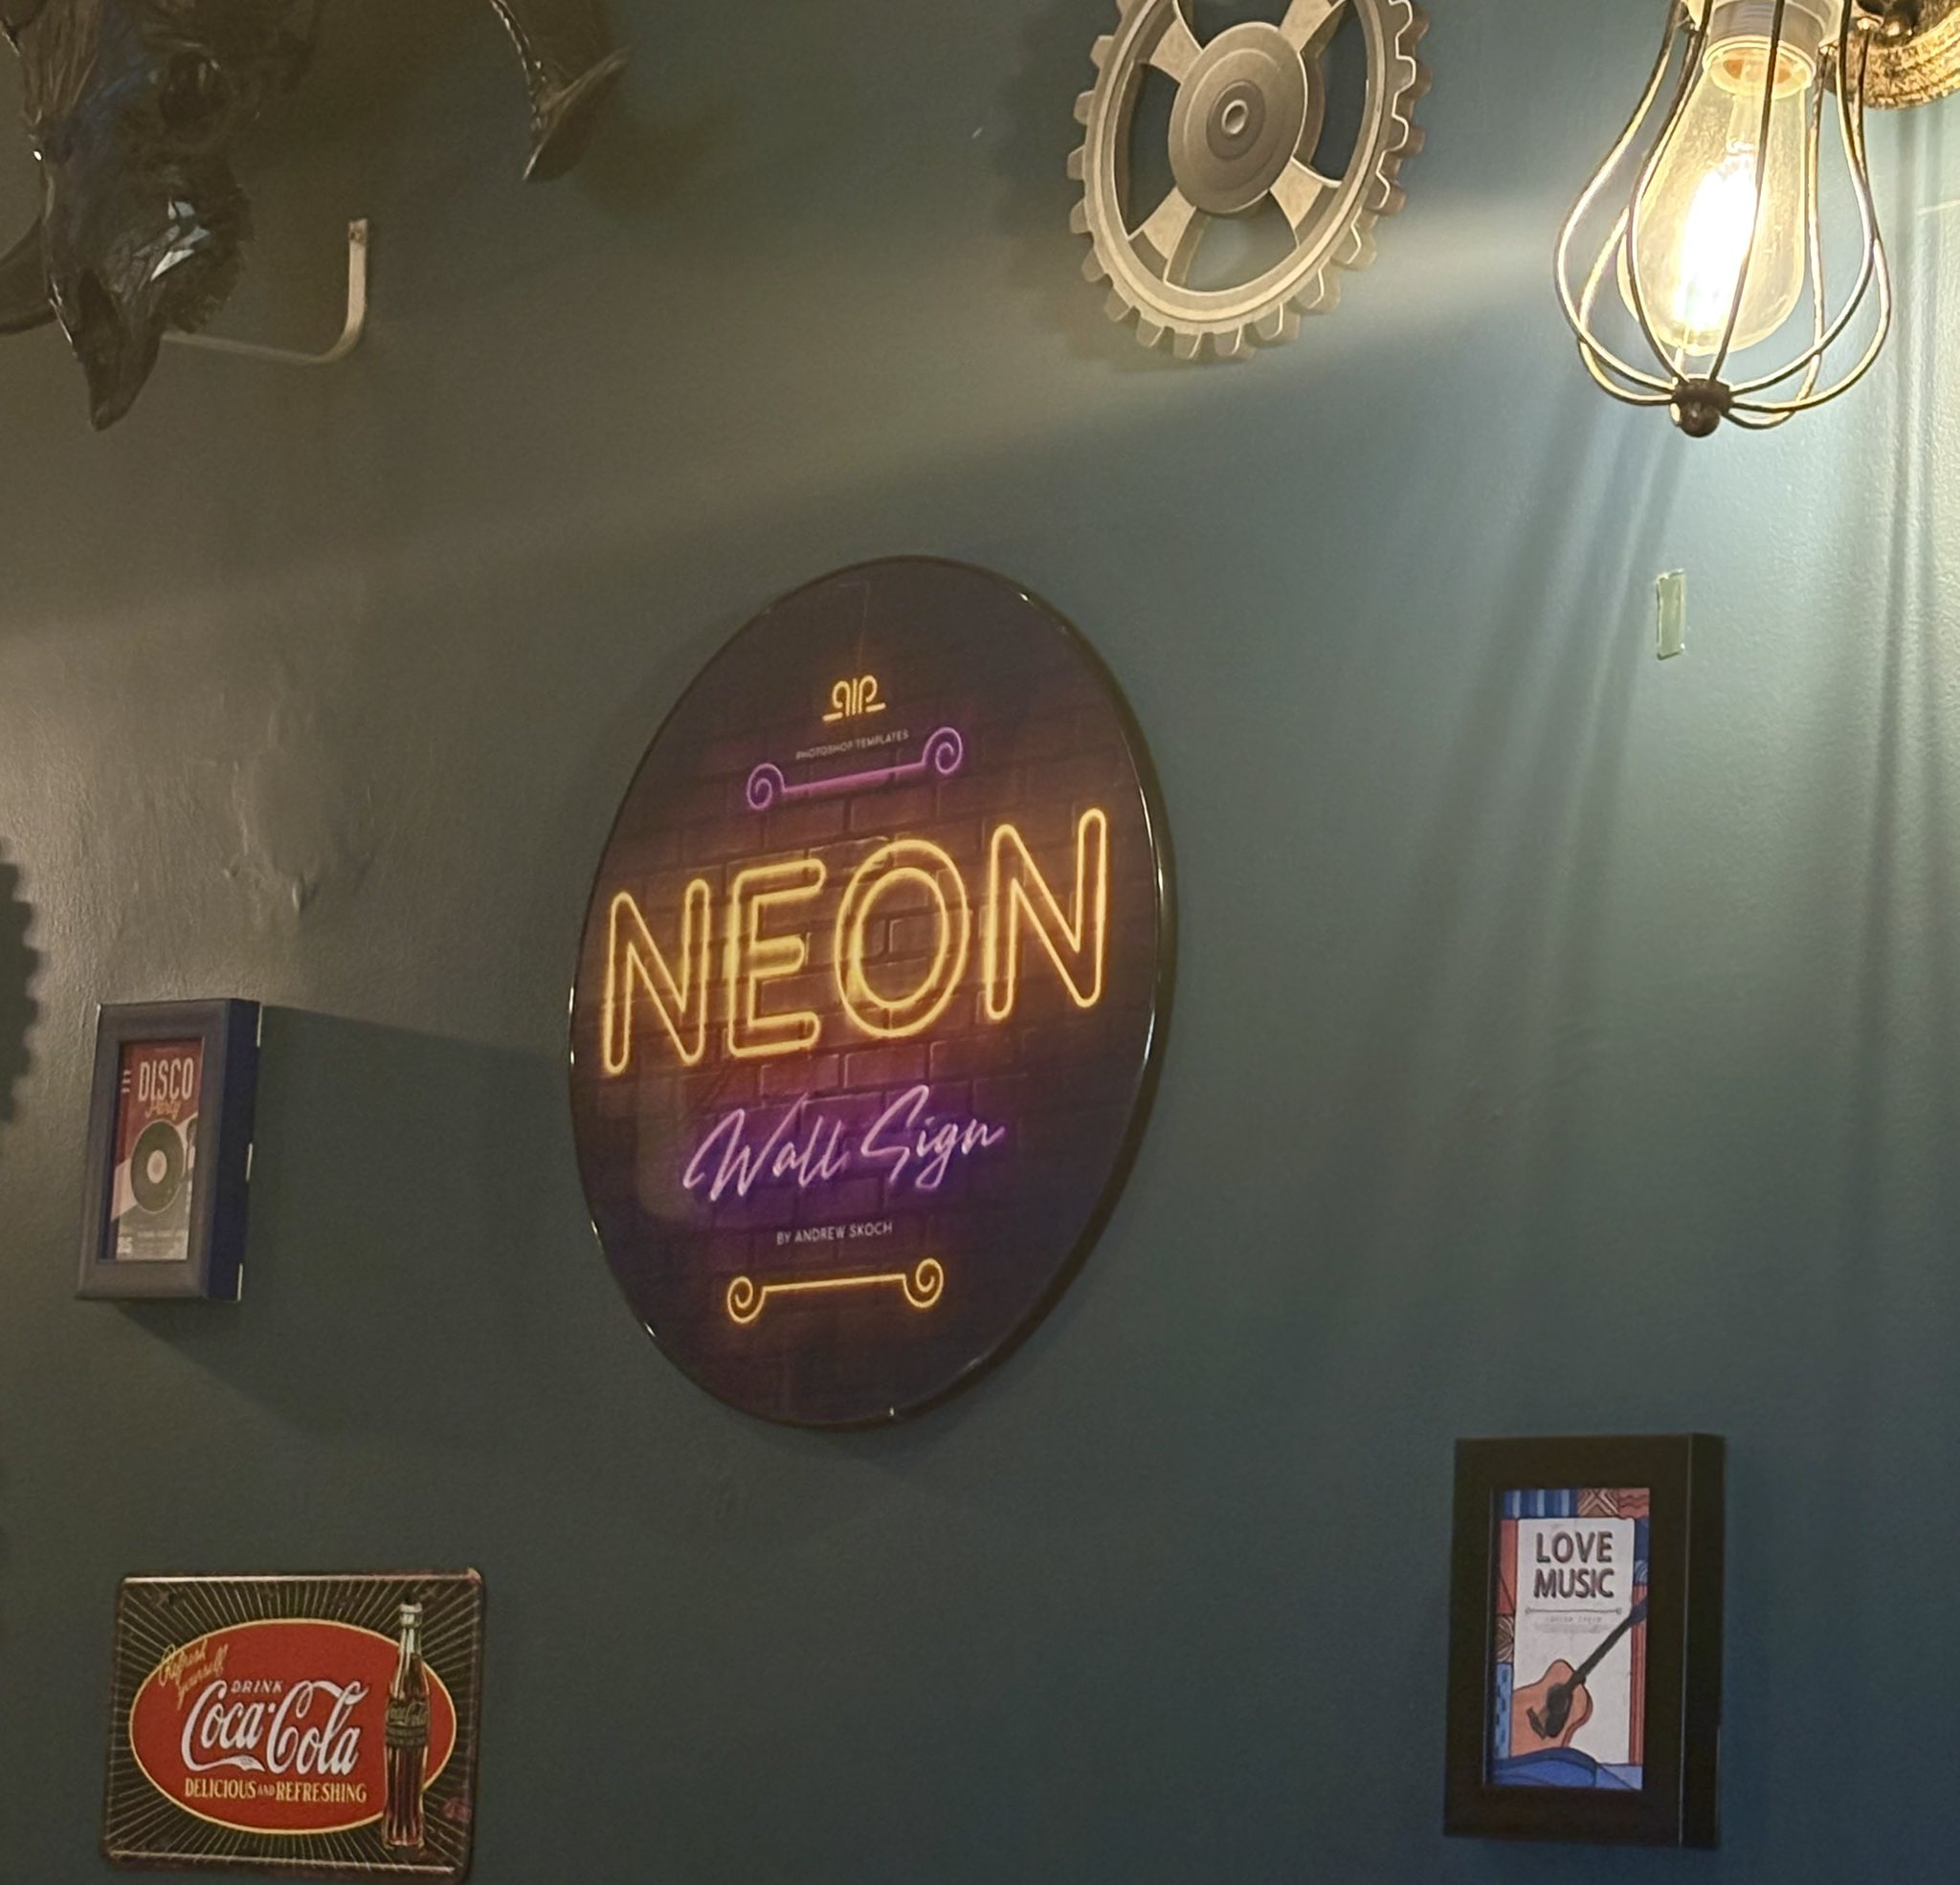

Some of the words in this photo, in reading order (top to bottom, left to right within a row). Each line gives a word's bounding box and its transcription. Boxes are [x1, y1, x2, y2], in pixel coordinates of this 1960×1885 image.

[855, 728, 909, 750] TEMPLATES
[601, 807, 1108, 1075] NEON
[138, 1056, 194, 1102] DISCO
[682, 1092, 850, 1202] Wall
[860, 1084, 1006, 1190] Sign
[776, 1231, 791, 1246] BY
[794, 1226, 846, 1243] ANDREW
[849, 1221, 893, 1239] SKOCH
[1535, 1531, 1614, 1563] LOVE
[1533, 1567, 1615, 1599] MUSIC
[231, 1679, 284, 1695] DRINK
[185, 1777, 256, 1800] DELICIOUS
[257, 1784, 275, 1797] AND
[275, 1780, 368, 1804] REFRESHING
